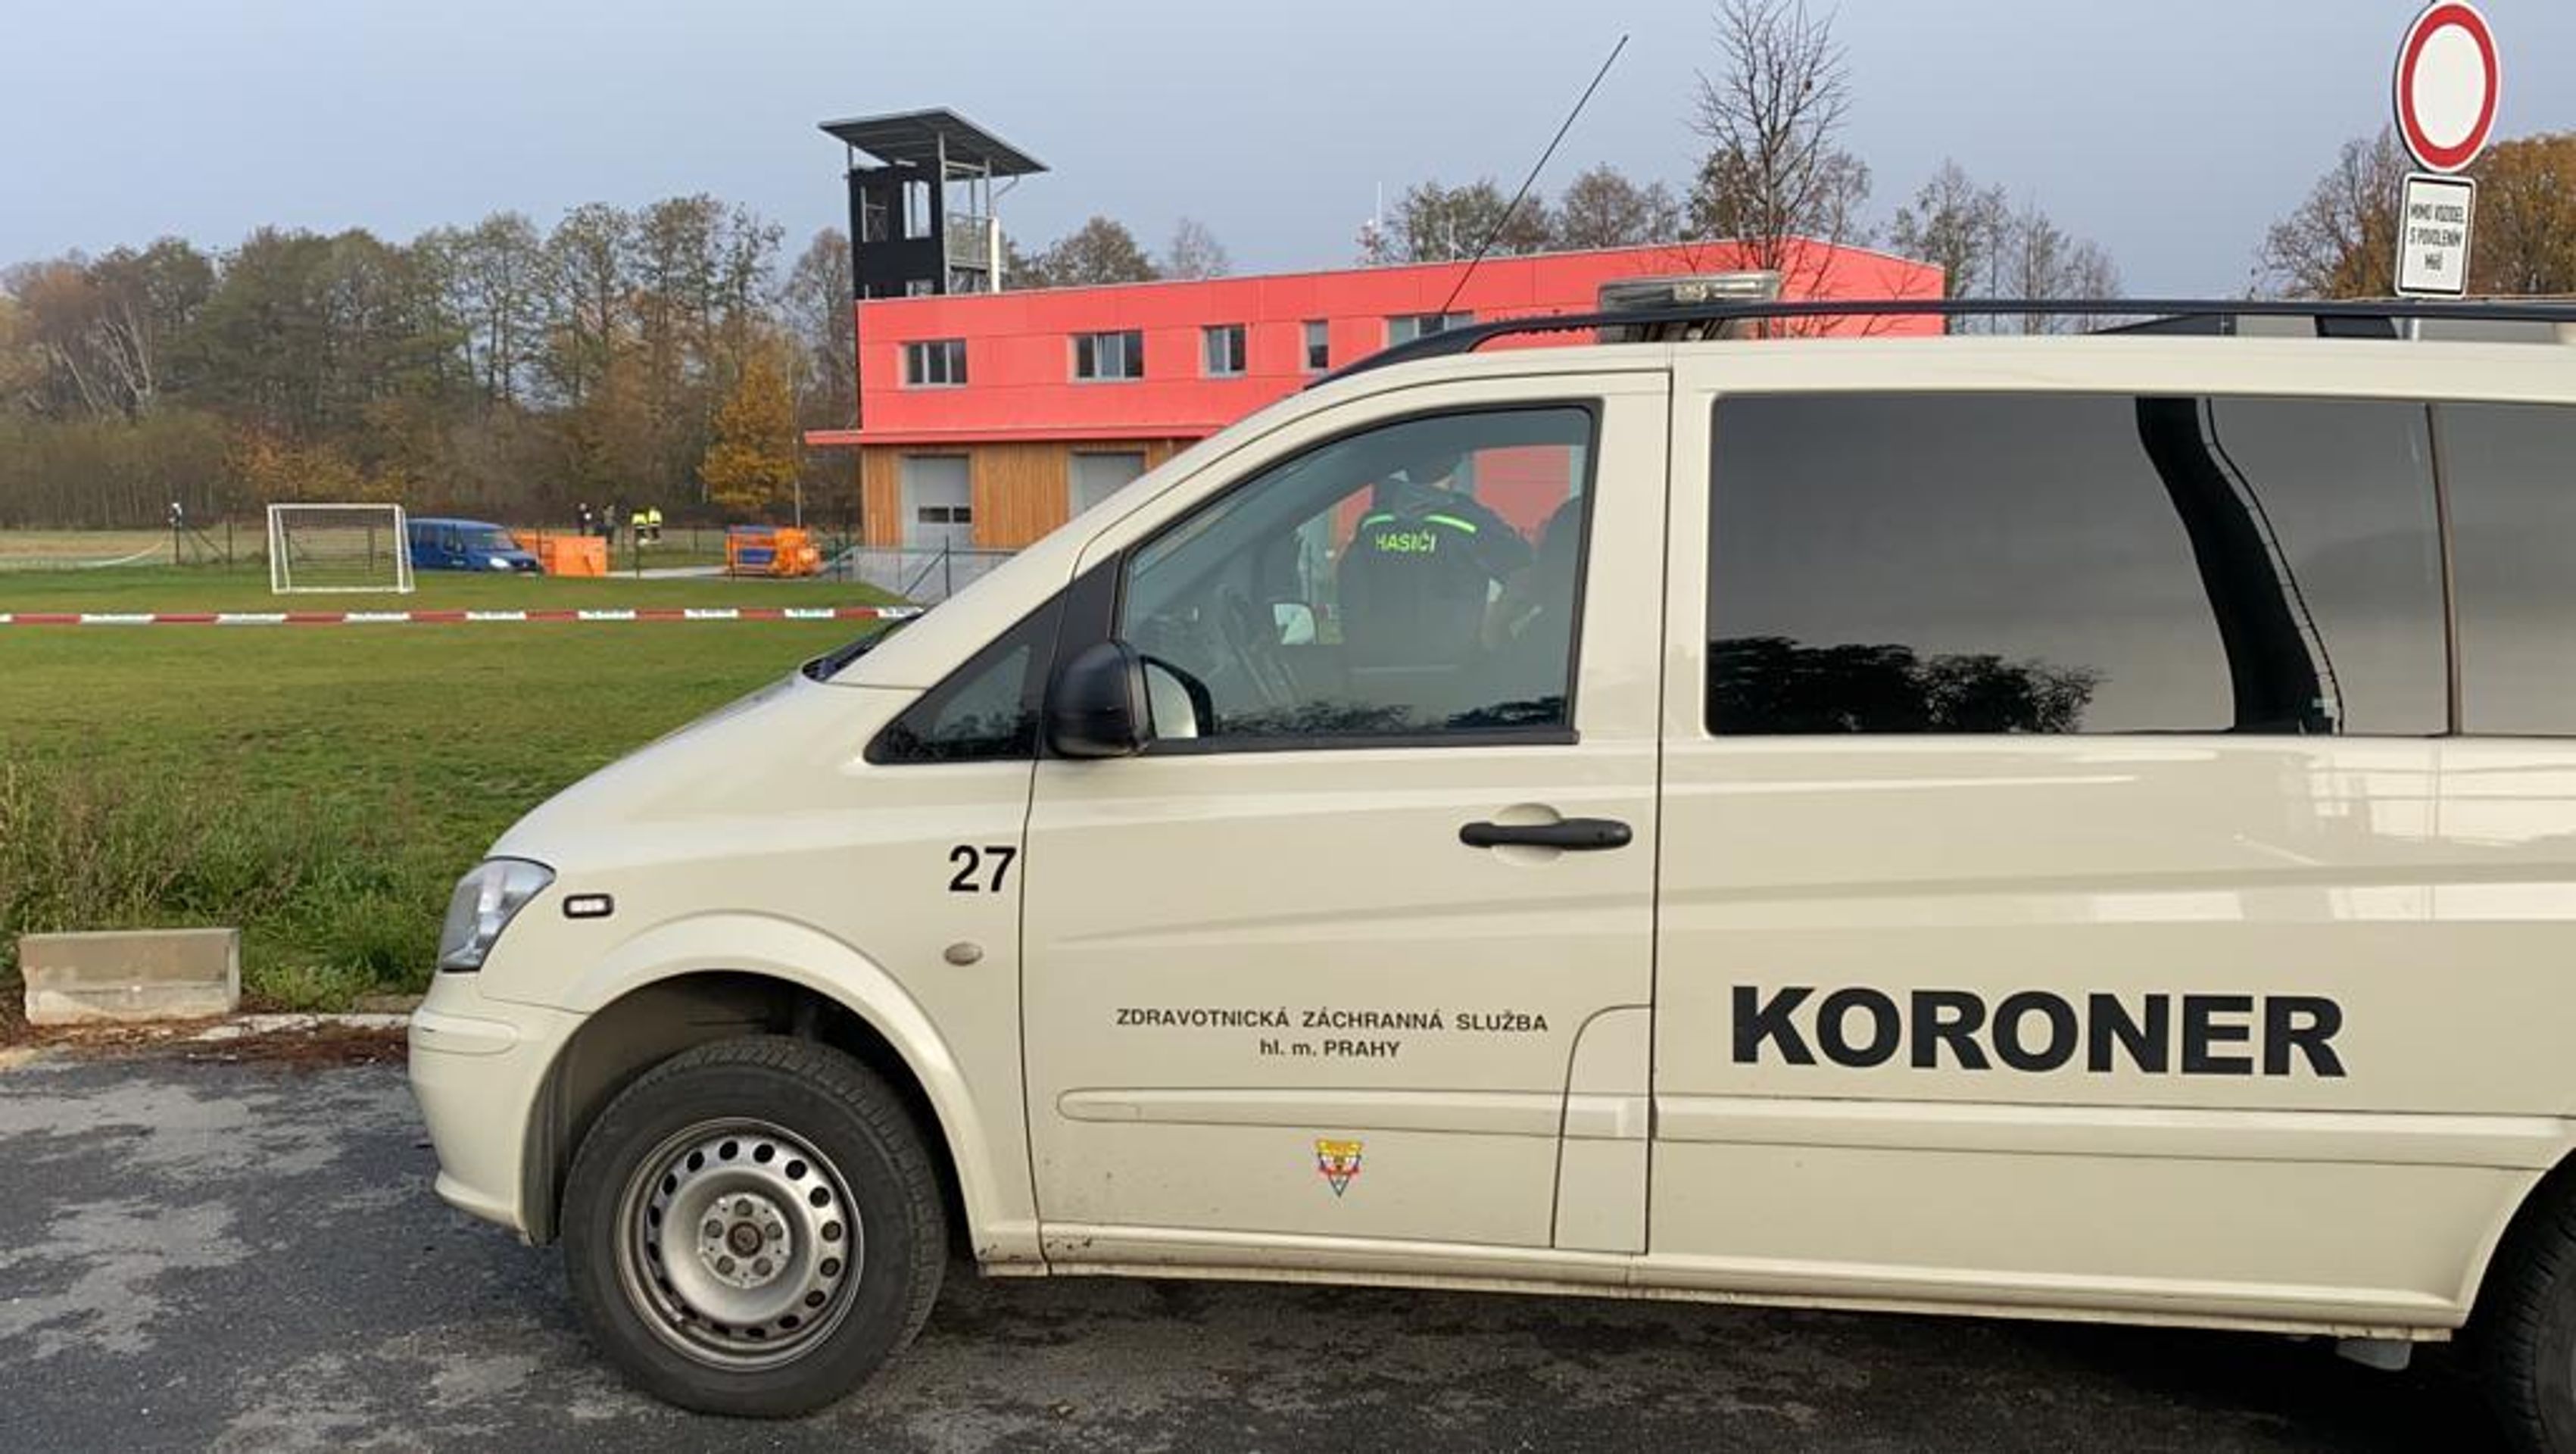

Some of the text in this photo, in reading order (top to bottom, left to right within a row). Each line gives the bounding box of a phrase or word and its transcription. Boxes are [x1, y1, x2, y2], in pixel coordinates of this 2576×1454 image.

[1375, 529, 1436, 553] HASIČI
[949, 844, 1017, 893] 27
[1116, 1006, 1549, 1032] ZDRAVOTNICKÁ ZÁCHRANNÁ SLUŽBA
[1731, 985, 2347, 1078] KORONER
[1259, 1038, 1401, 1058] hl. m. PRAHY
